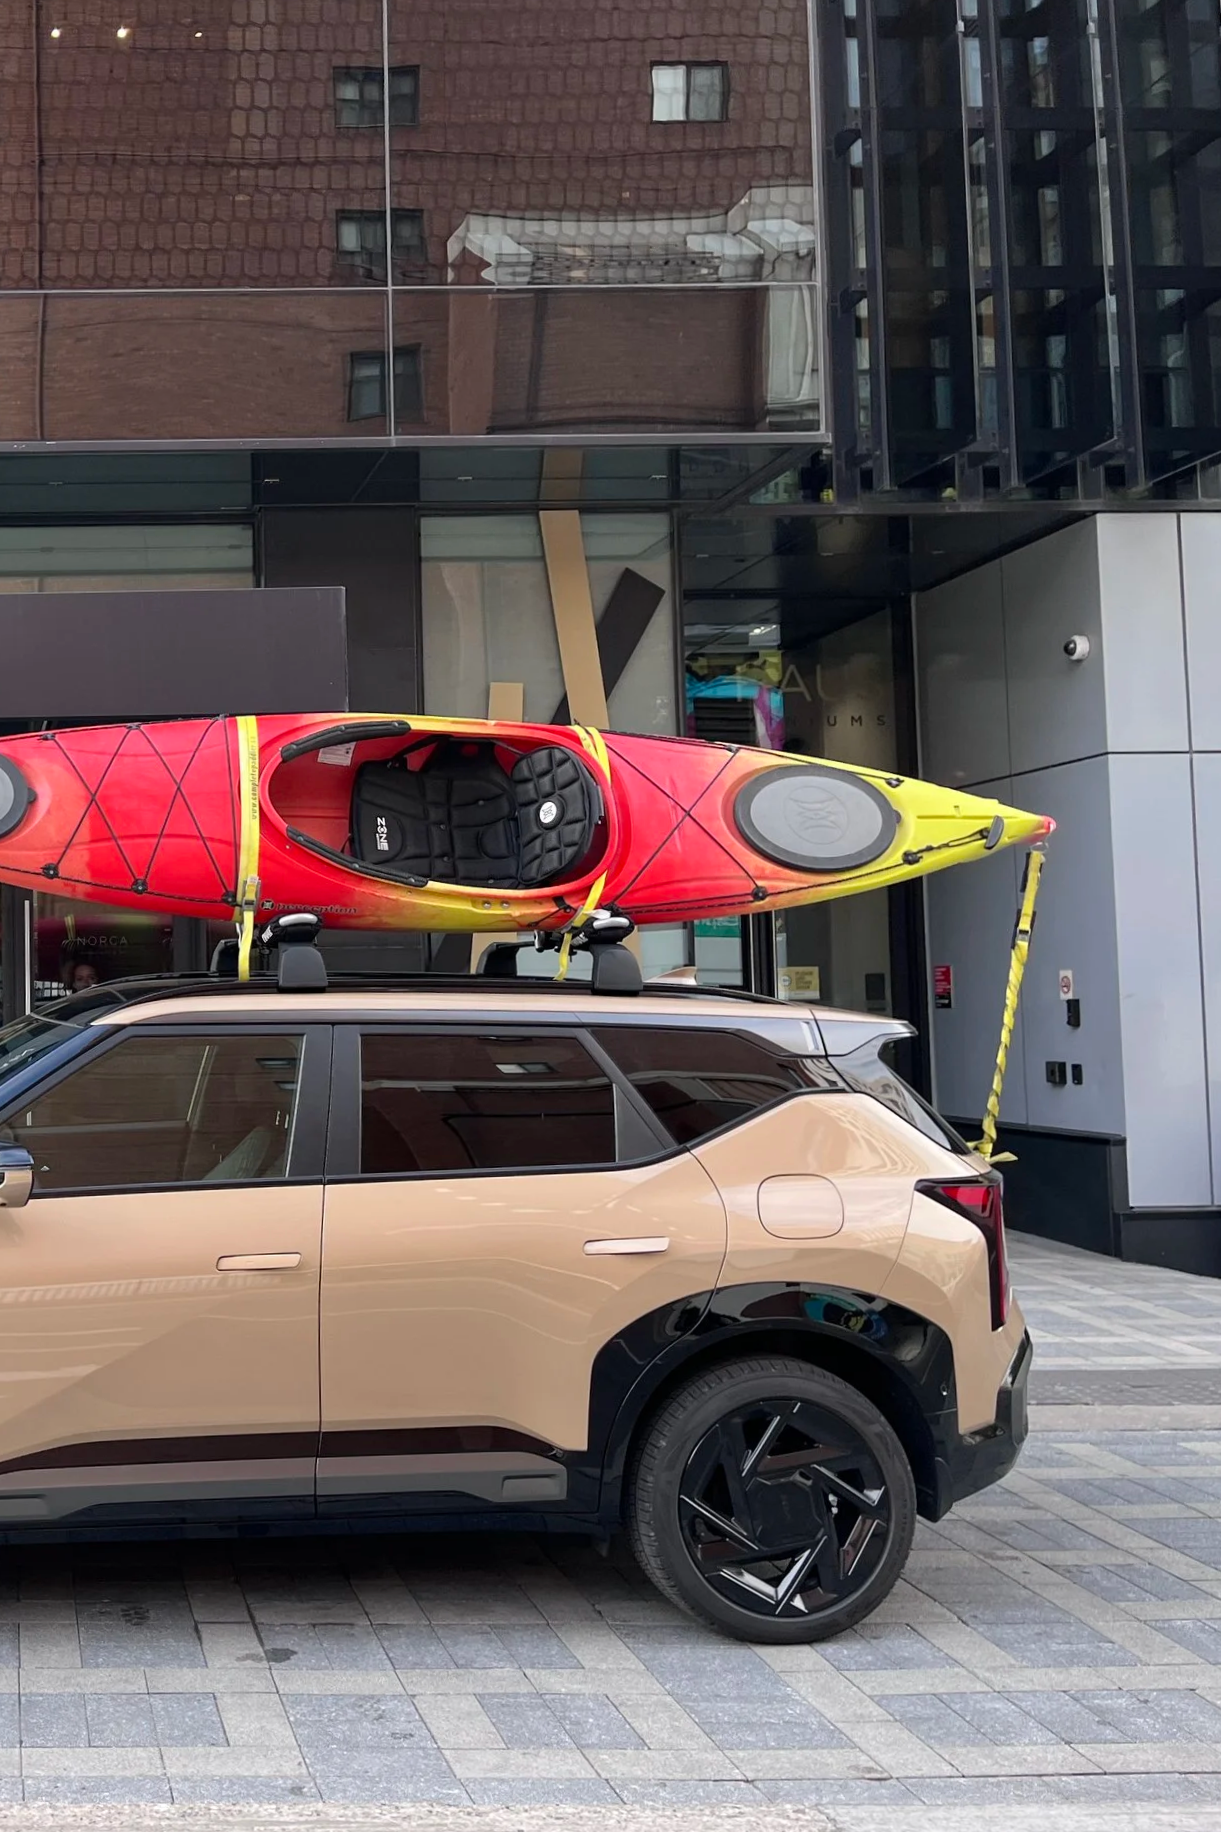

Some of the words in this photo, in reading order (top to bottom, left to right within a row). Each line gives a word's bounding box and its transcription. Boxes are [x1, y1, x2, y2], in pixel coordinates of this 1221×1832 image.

[377, 816, 389, 851] ZONE
[276, 902, 358, 914] perception
[76, 935, 128, 946] NORCA
